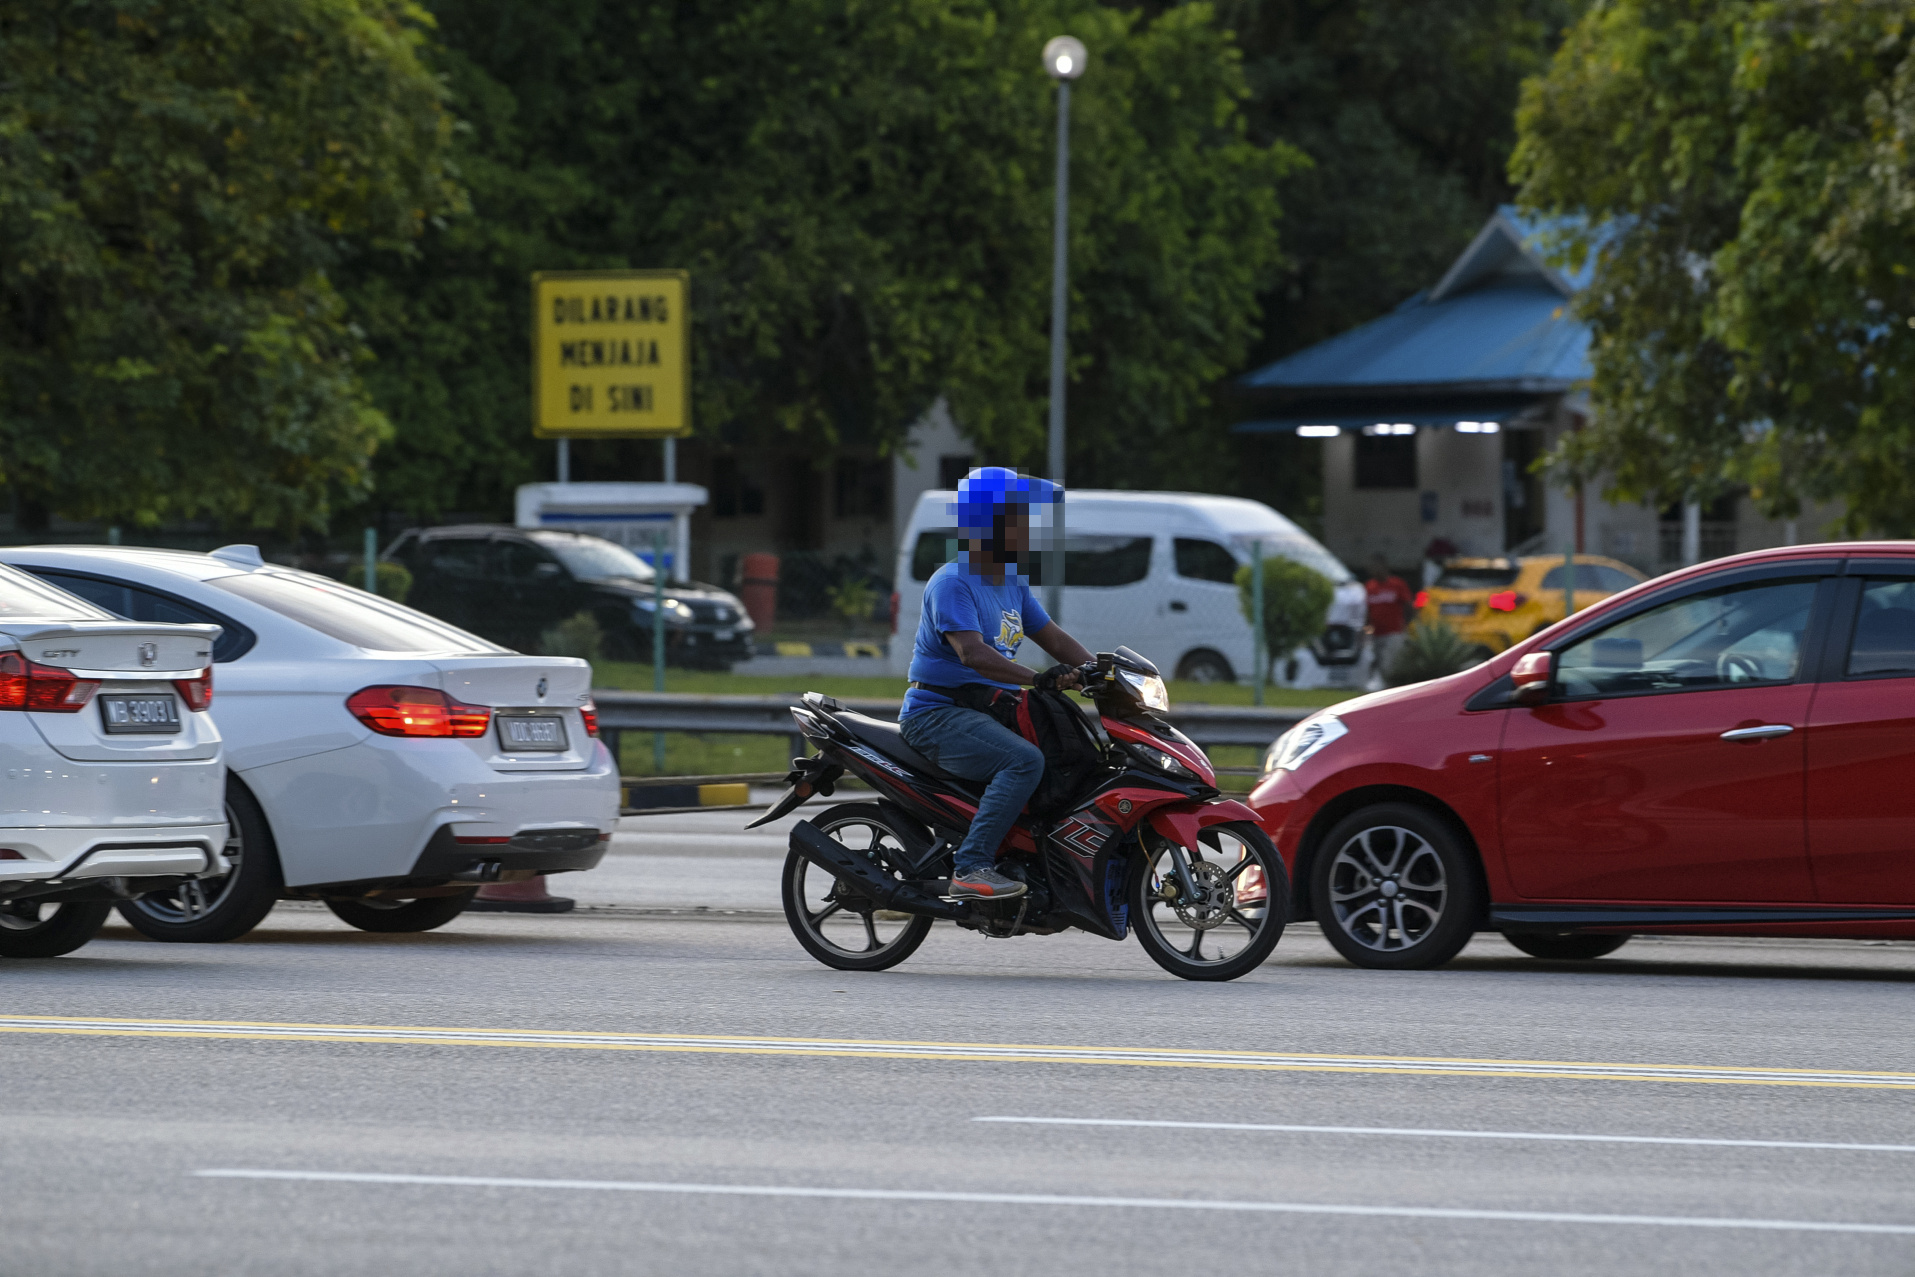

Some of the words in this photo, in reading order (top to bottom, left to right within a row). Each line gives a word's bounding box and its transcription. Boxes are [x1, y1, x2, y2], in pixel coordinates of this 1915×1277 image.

[554, 295, 668, 324] DILARANG
[561, 337, 660, 368] MENJAJA
[570, 384, 593, 414] DI
[608, 384, 653, 413] SINI
[129, 700, 168, 723] 3903
